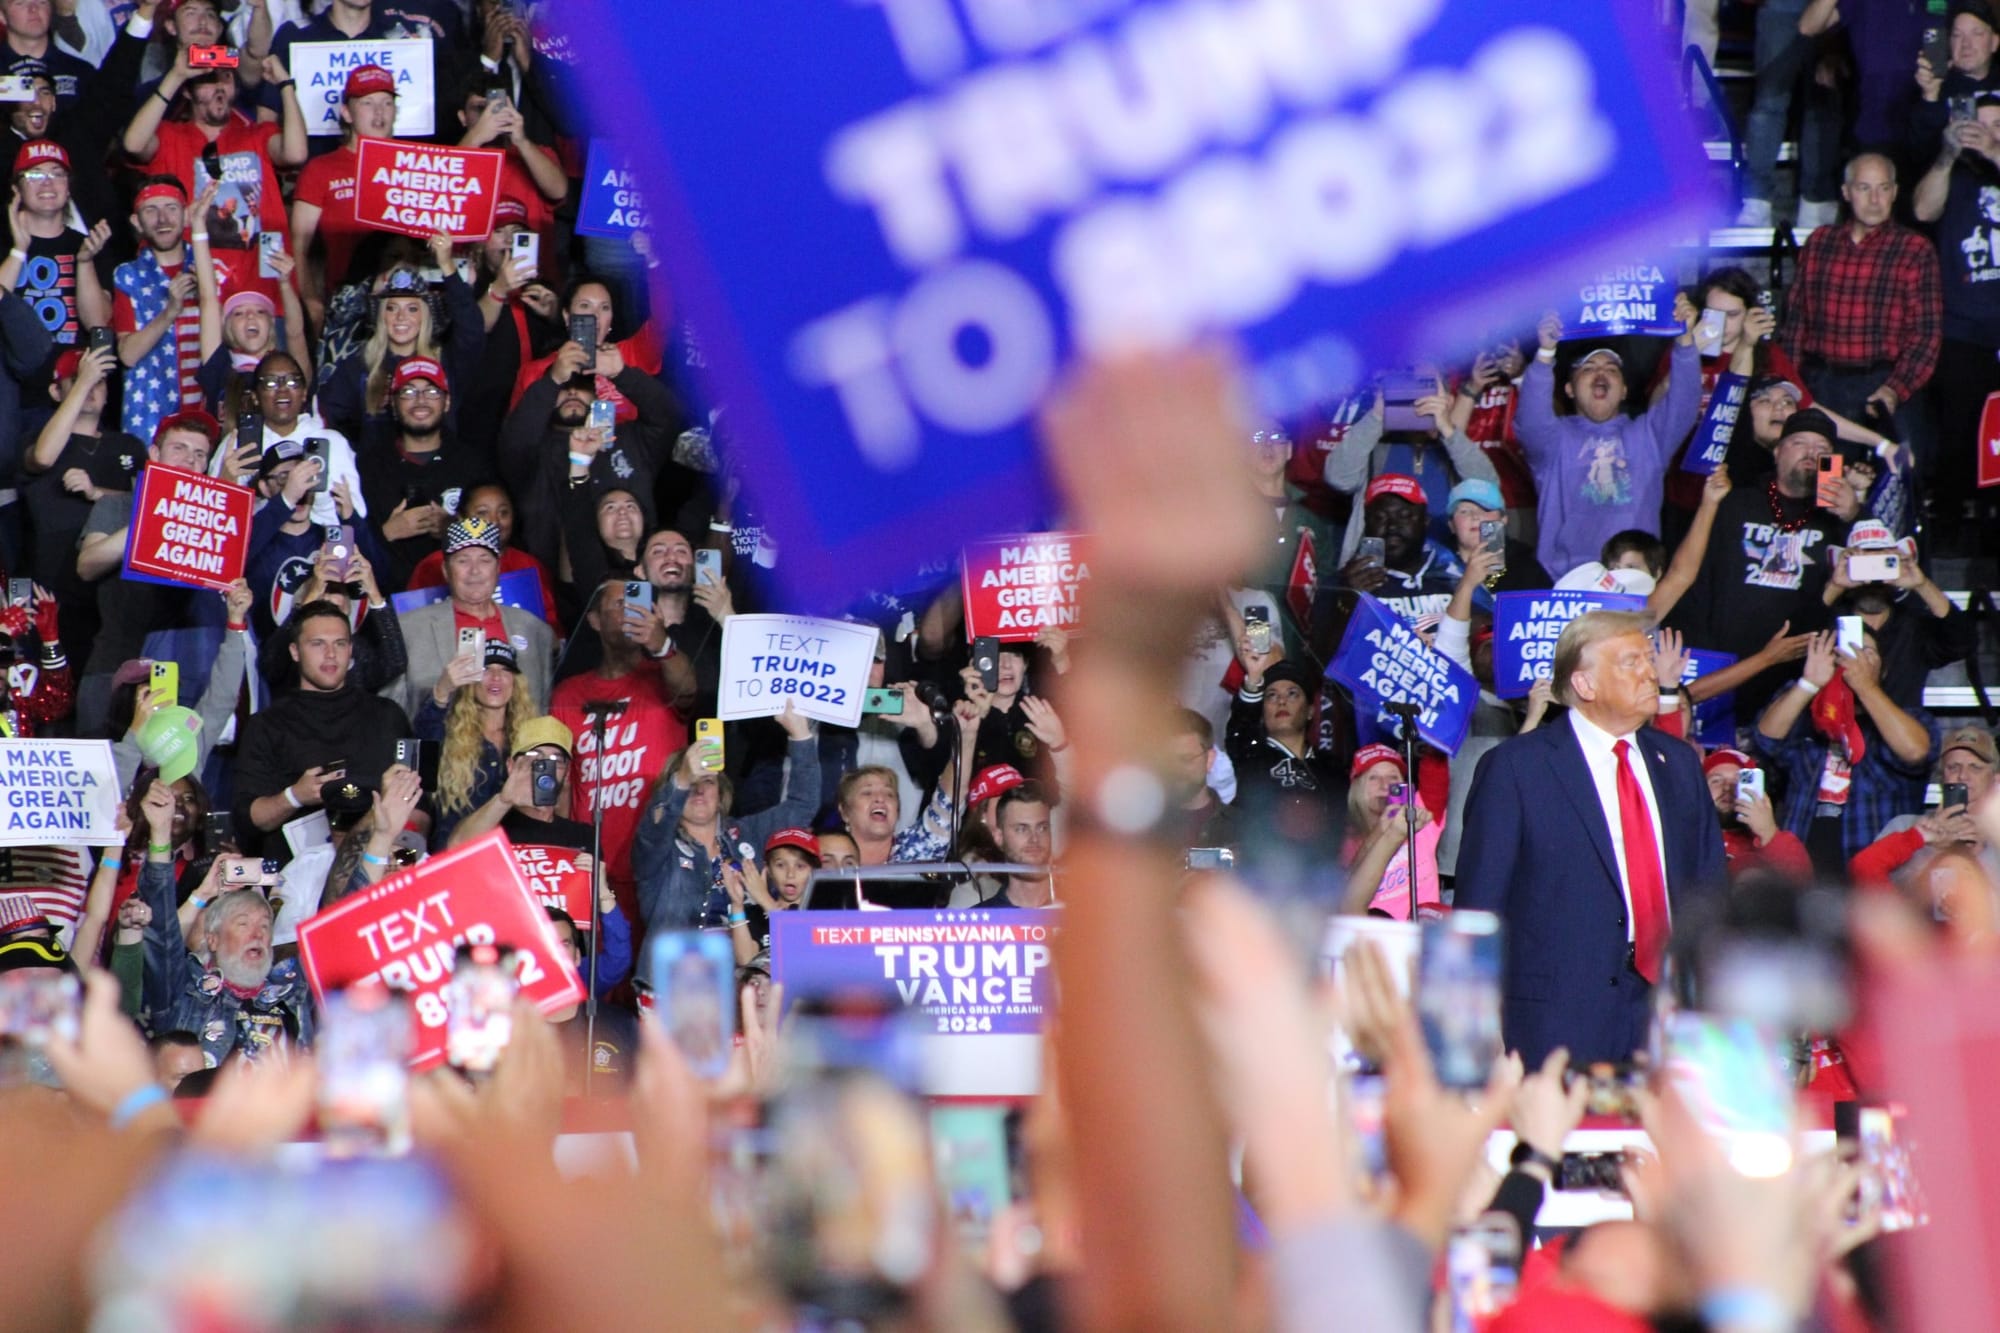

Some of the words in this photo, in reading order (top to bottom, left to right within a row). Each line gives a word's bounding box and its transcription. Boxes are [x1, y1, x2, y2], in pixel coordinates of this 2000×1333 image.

[329, 51, 393, 67] MAKE
[28, 144, 64, 160] MAGA
[395, 151, 466, 174] MAKE
[372, 167, 482, 194] AMERICA
[385, 187, 467, 212] GREAT
[382, 206, 466, 230] AGAIN!
[1580, 283, 1655, 302] GREAT
[1580, 303, 1657, 323] AGAIN!
[785, 258, 1053, 470] TO
[174, 480, 228, 510] MAKE
[153, 498, 238, 536] AMERICA
[162, 521, 227, 553] GREAT
[154, 542, 224, 575] AGAIN!
[1000, 543, 1071, 566] MAKE
[981, 563, 1090, 588] AMERICA
[997, 584, 1079, 608] GREAT
[998, 606, 1080, 628] AGAIN!
[766, 633, 829, 655] TEXT
[1391, 622, 1450, 676] MAKE
[752, 656, 837, 678] TRUMP
[1364, 629, 1460, 704] AMERICA
[736, 679, 763, 698] TO
[770, 677, 847, 705] 88022
[1371, 652, 1445, 708] GREAT
[619, 721, 638, 746] U
[6, 750, 74, 767] MAKE
[8, 790, 86, 808] GREAT
[8, 811, 90, 830] AGAIN!
[357, 890, 454, 960] TEXT
[817, 928, 865, 944] TEXT
[870, 926, 1015, 943] PENNSYLVANIA
[1021, 926, 1046, 941] TO
[875, 945, 1050, 978] TRUMP
[896, 977, 1032, 1006] VANCE
[969, 1005, 1002, 1014] GREAT
[1006, 1004, 1043, 1014] AGAIN!
[938, 1017, 992, 1032] 2024
